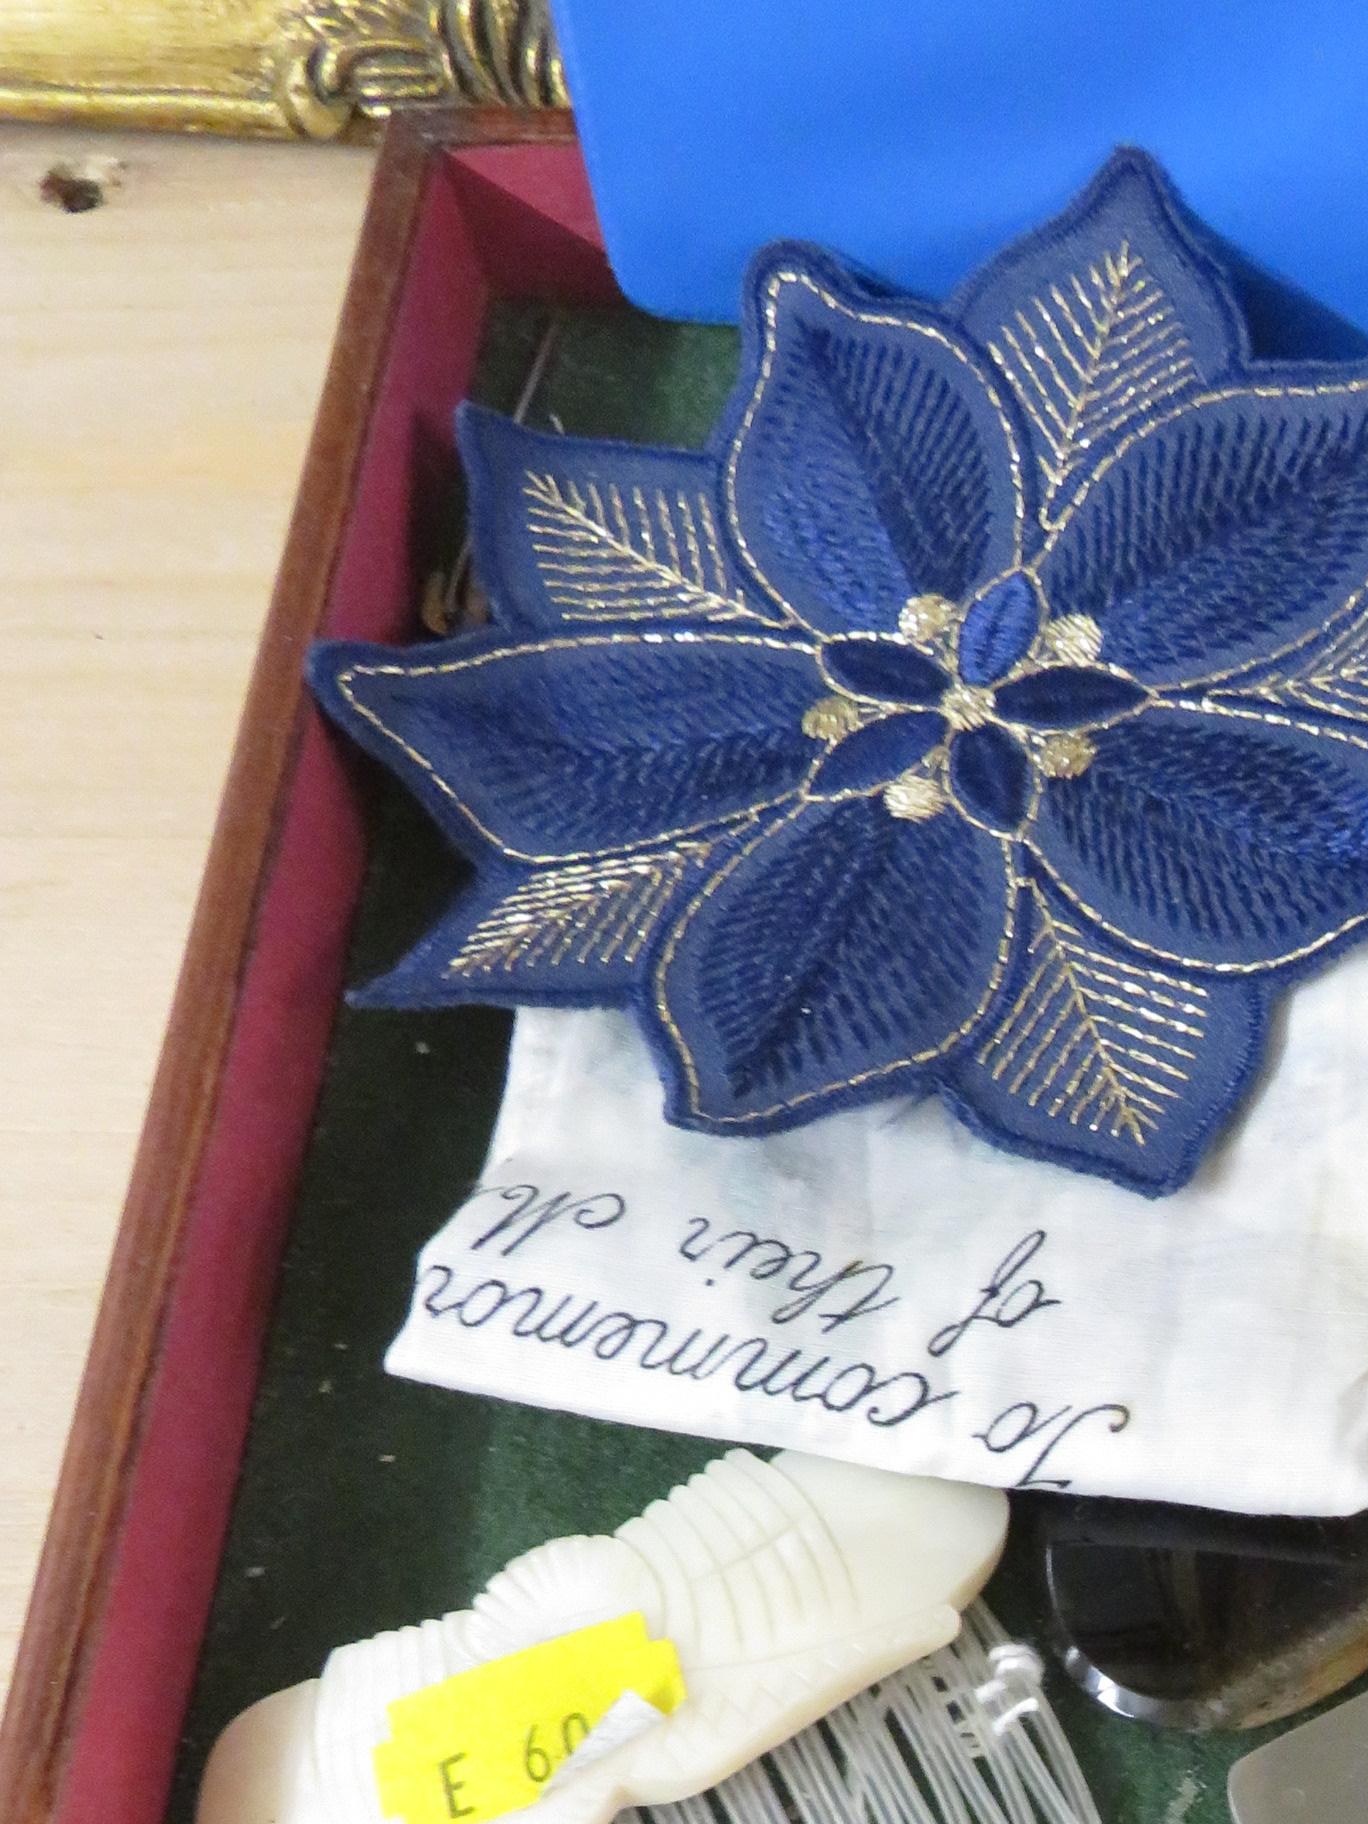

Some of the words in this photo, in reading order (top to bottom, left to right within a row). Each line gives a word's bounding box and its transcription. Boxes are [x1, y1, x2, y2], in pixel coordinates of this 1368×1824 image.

[678, 1217, 900, 1334] their
[927, 1230, 1062, 1358] of
[424, 1264, 958, 1428] commemor
[973, 1401, 1131, 1488] To
[440, 1753, 474, 1818] E
